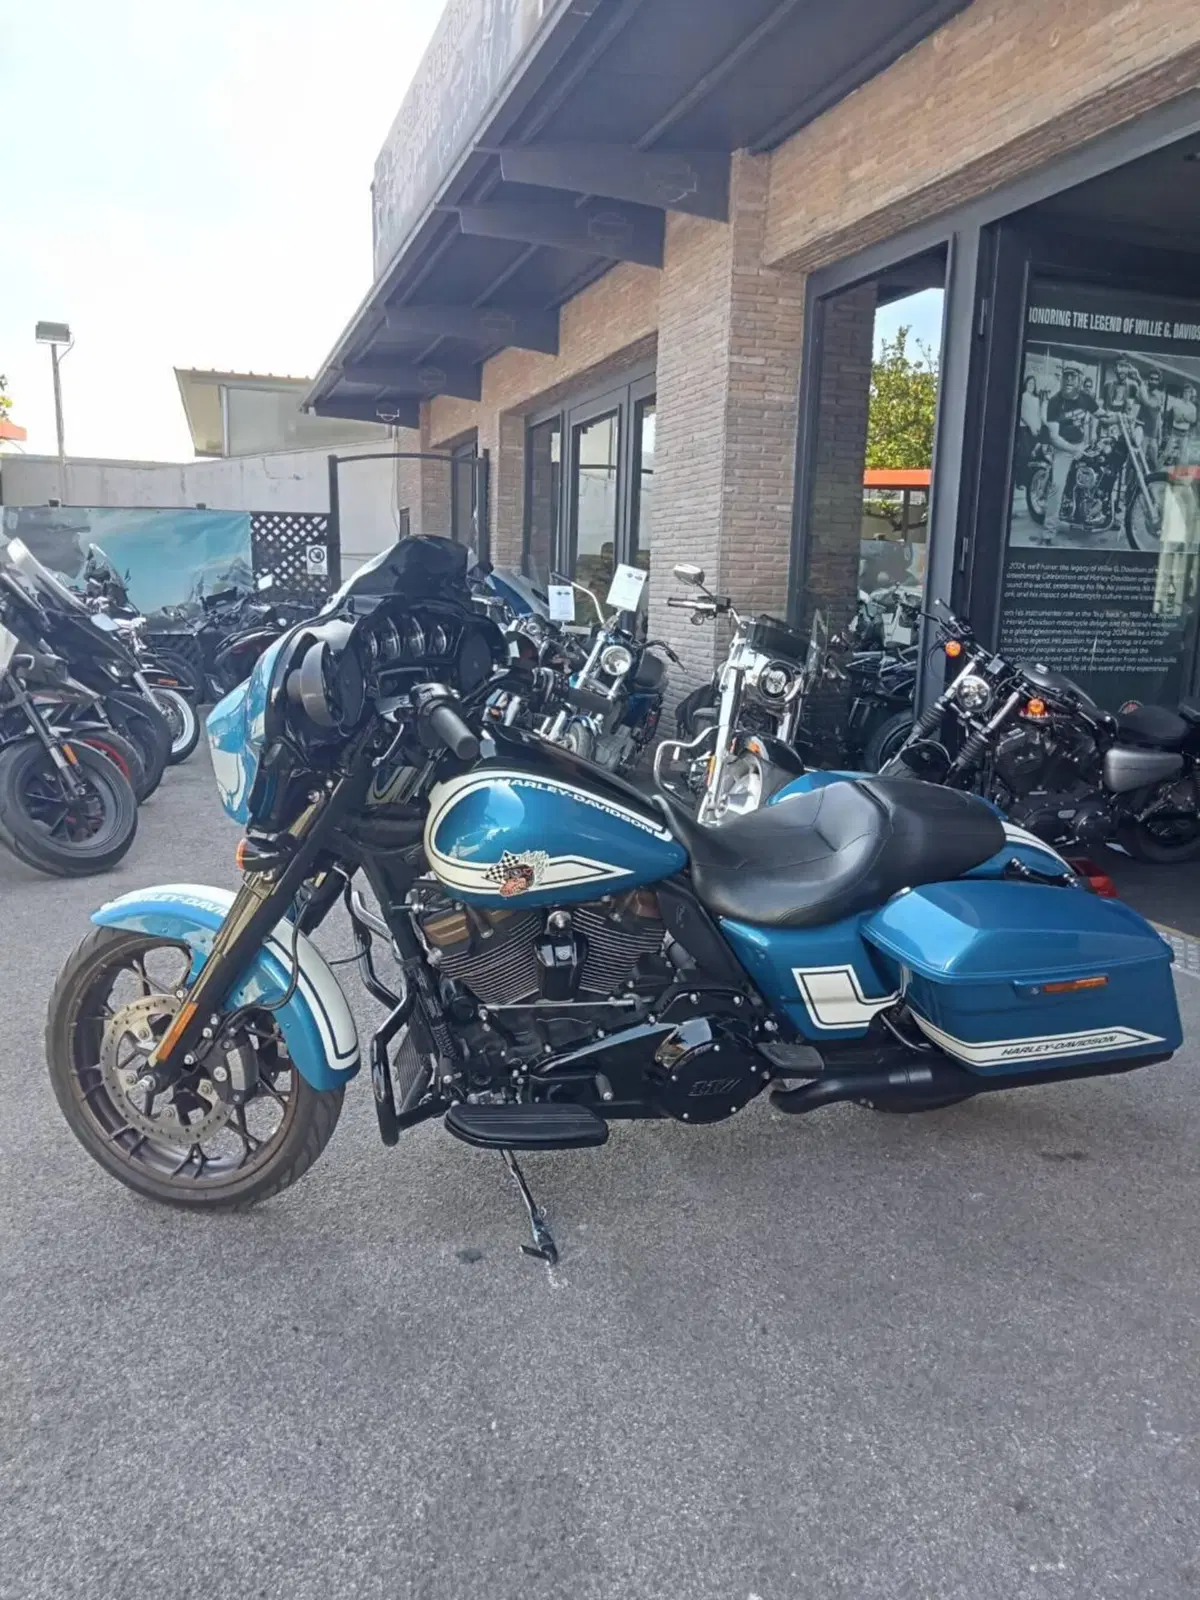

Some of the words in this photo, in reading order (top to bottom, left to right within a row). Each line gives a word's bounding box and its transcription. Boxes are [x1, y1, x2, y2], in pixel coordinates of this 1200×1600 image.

[1073, 311, 1088, 329] THE
[1090, 313, 1121, 333] LEGEND
[1123, 317, 1134, 334] OF
[1134, 318, 1162, 337] WILLIE
[1163, 321, 1172, 339] G.
[493, 778, 657, 833] HARLEY-DAVIDSON
[1001, 1035, 1117, 1056] HARLEY-DAVIDSON
